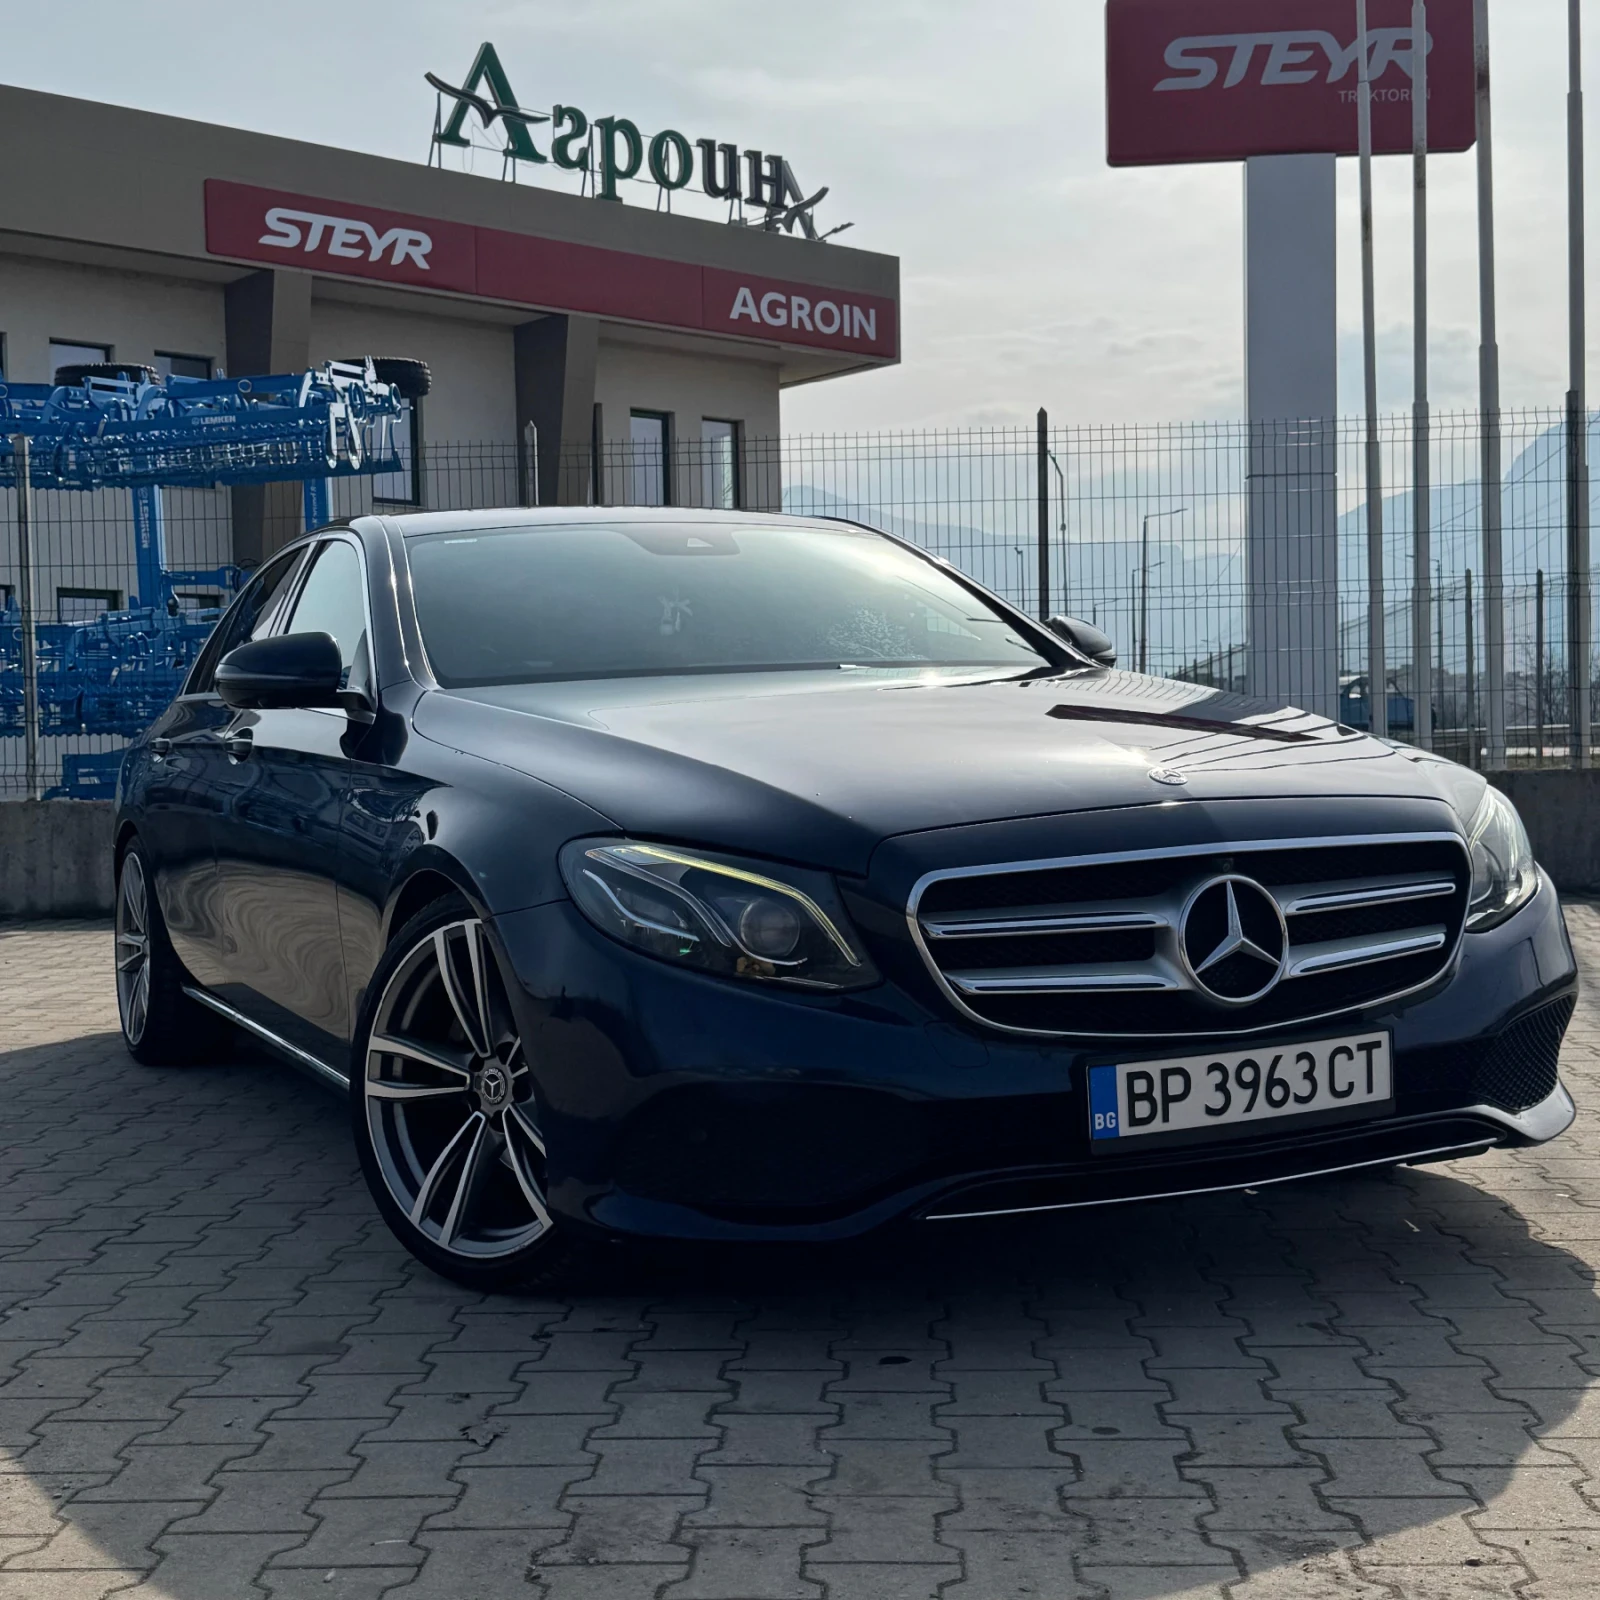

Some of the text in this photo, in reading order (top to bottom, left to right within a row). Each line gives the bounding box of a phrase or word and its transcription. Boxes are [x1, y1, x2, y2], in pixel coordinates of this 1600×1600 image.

[1153, 27, 1433, 91] STEYR
[1338, 88, 1431, 103] TRKTOR
[258, 207, 432, 270] STEYR
[730, 287, 876, 341] AGROIN
[1126, 1040, 1382, 1127] BP 3963 CT
[1094, 1111, 1117, 1130] BG
